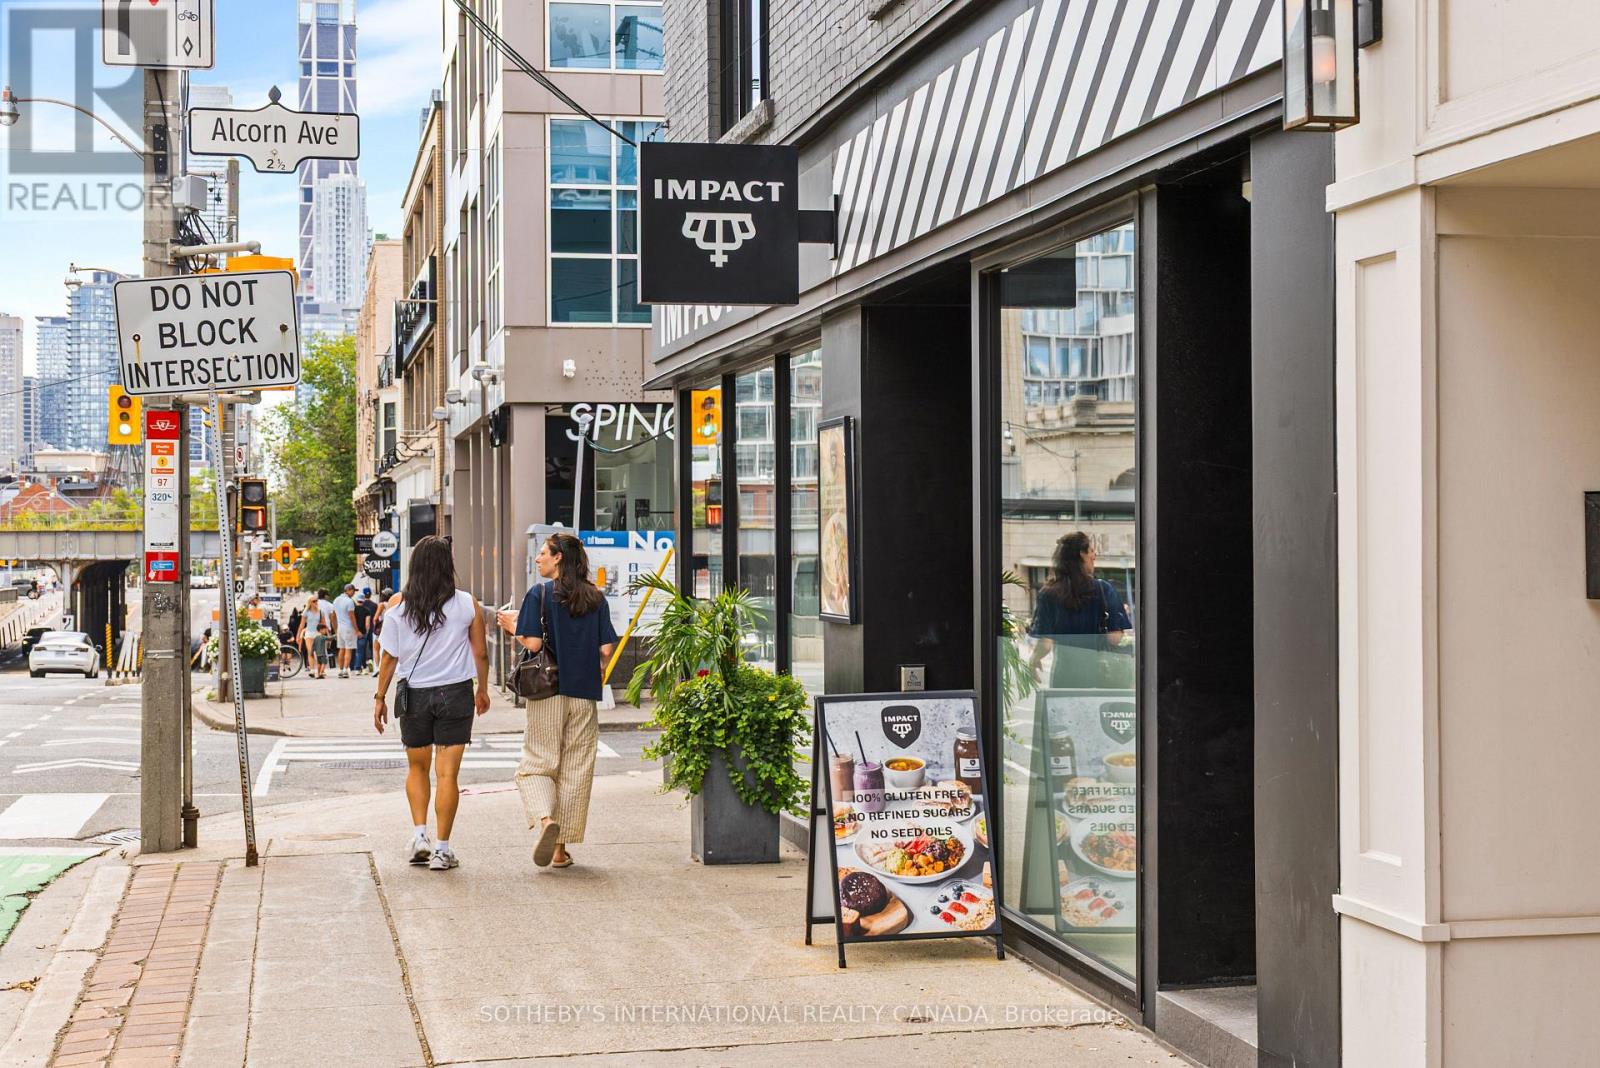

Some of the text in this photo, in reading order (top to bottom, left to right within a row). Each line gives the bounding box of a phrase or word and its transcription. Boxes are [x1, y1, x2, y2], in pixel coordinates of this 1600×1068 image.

[211, 117, 339, 145] Alcorn Ave
[654, 178, 785, 202] IMPACT
[150, 279, 258, 312] DO NOT
[158, 317, 258, 349] BLOCK
[127, 352, 295, 389] INTERSECTION
[157, 478, 168, 487] 97
[151, 492, 168, 502] 320
[851, 789, 965, 804] 100% GLUTEN FREE
[849, 806, 971, 822] NO REFINED SUGARS
[871, 826, 953, 840] NO SEED OILS
